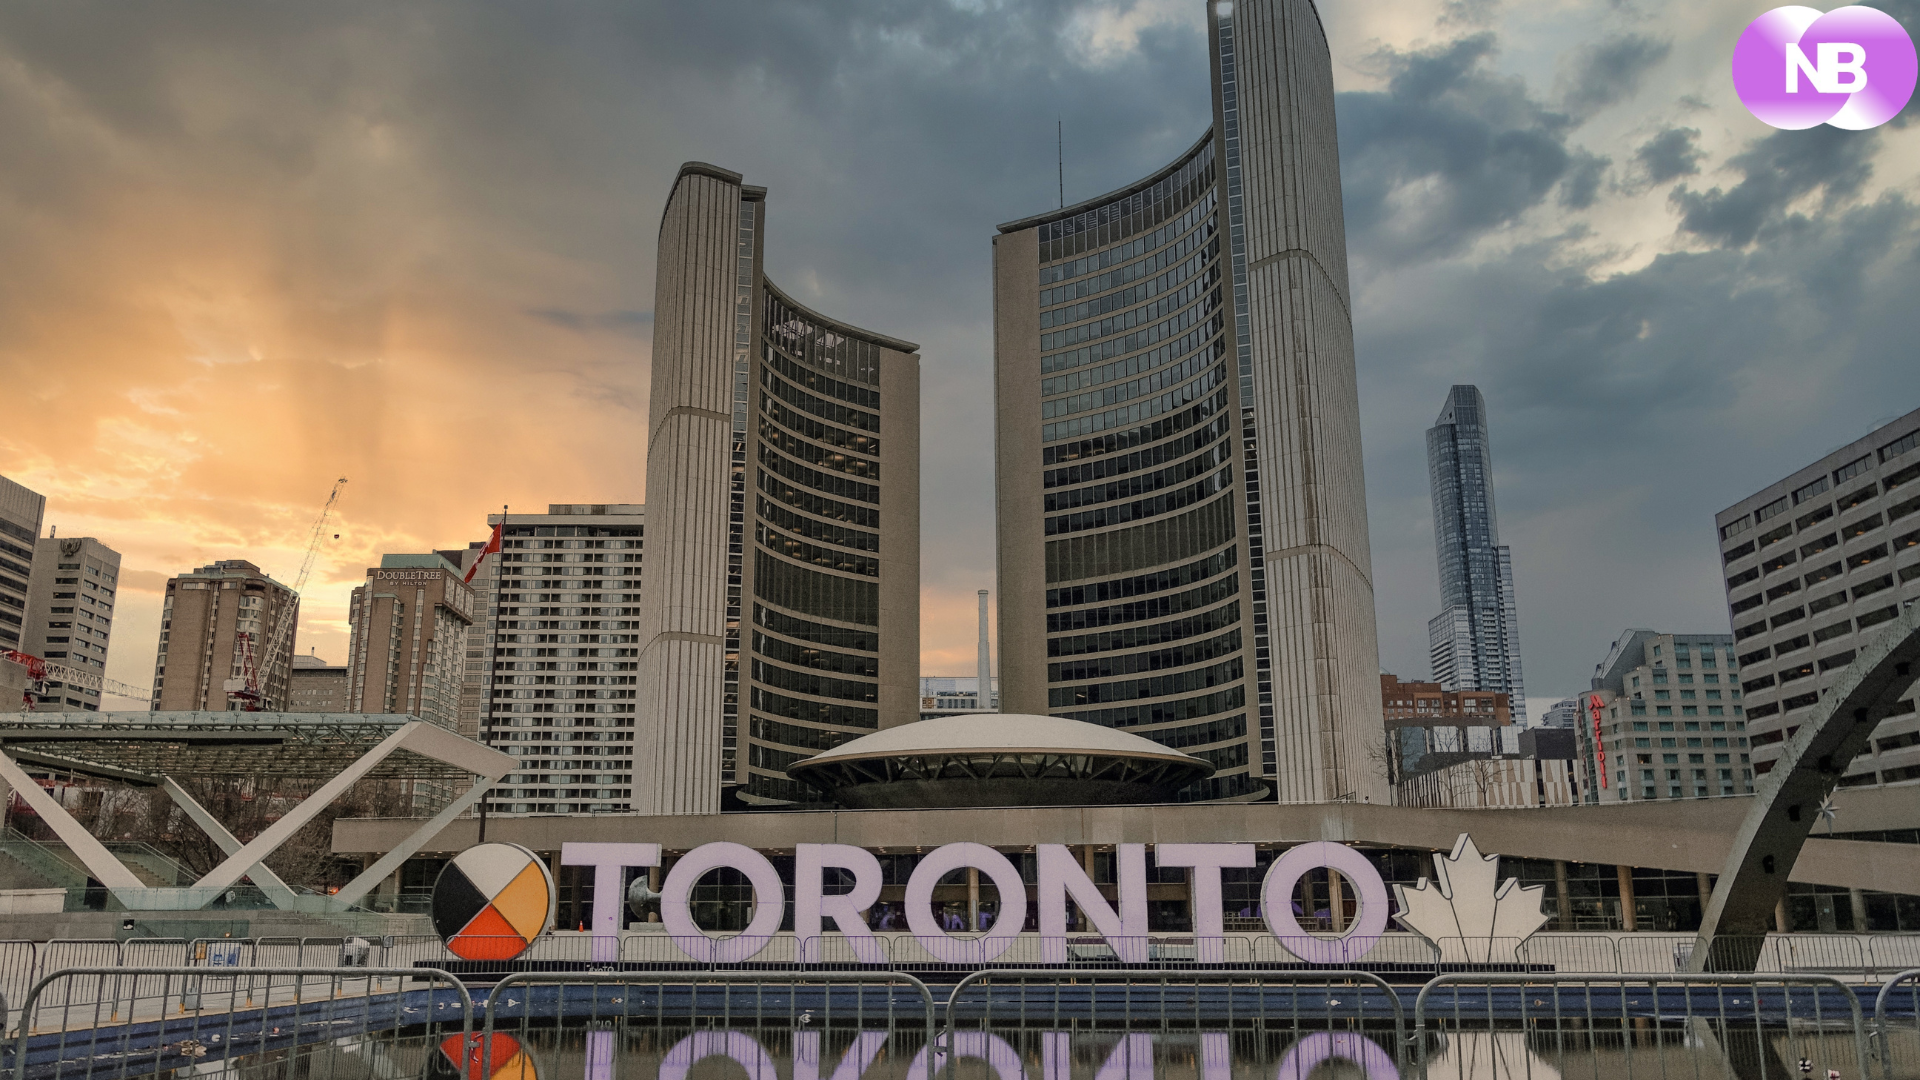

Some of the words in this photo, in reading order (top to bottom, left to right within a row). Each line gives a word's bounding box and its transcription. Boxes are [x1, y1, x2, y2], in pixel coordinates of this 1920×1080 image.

[377, 571, 441, 580] DOUBLETREE
[1588, 695, 1607, 788] Marriott
[560, 841, 1389, 963] TORONTO
